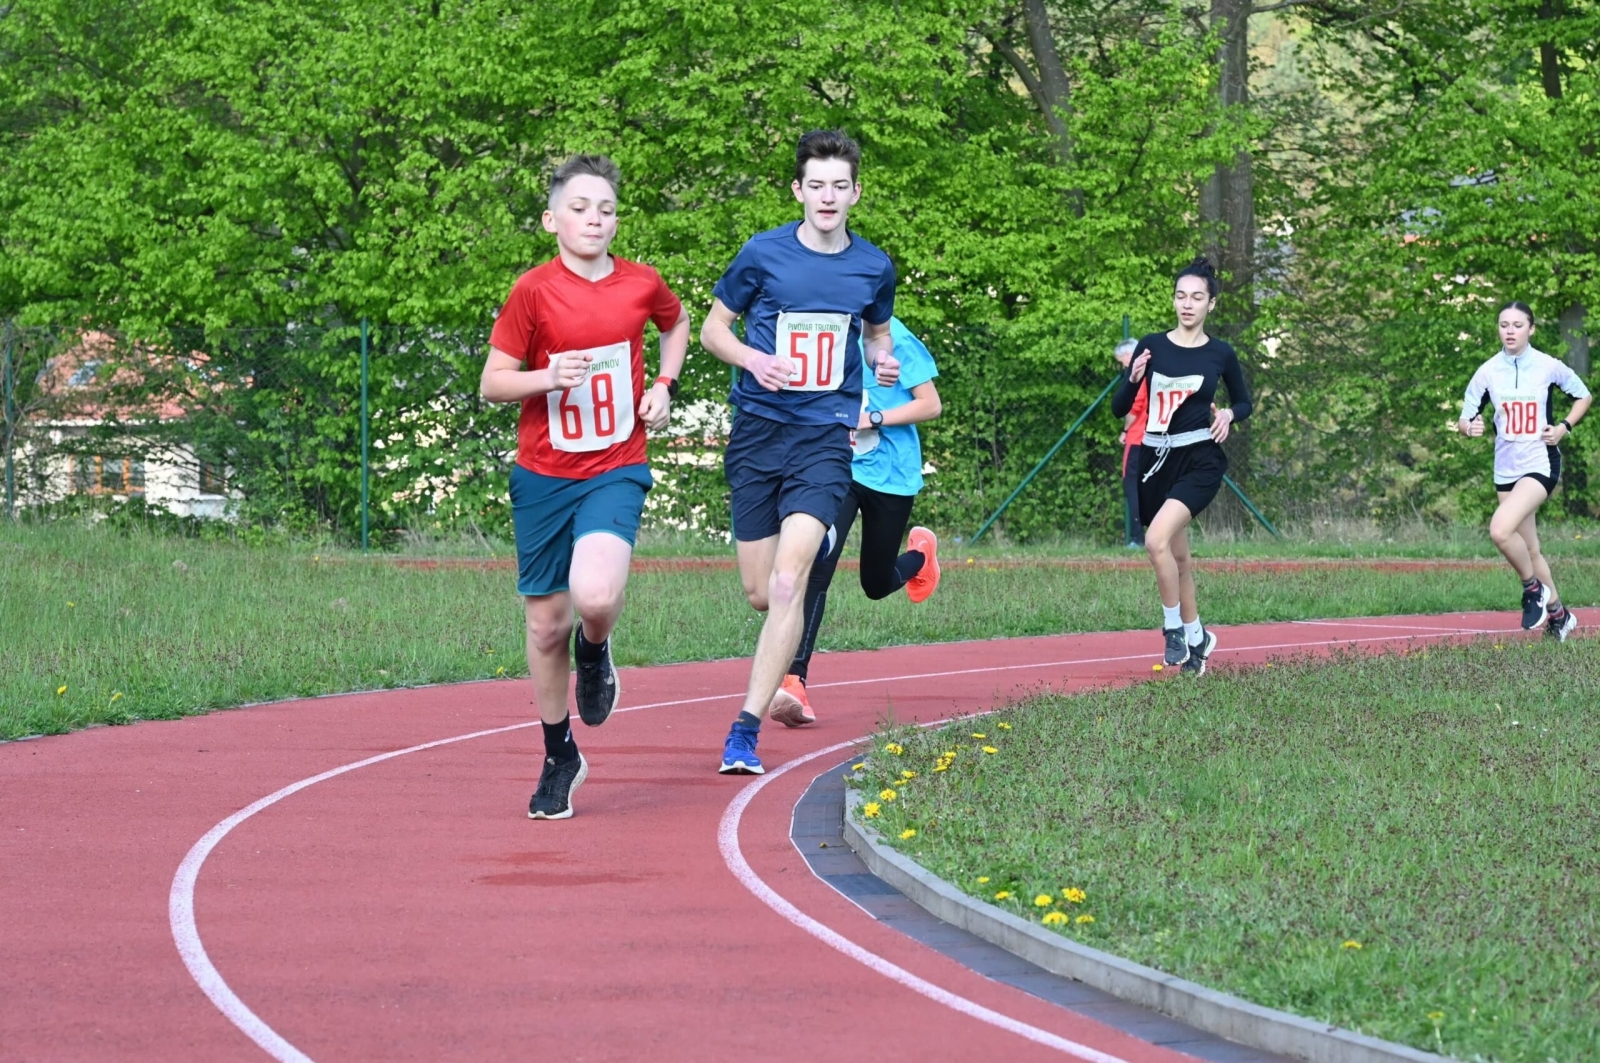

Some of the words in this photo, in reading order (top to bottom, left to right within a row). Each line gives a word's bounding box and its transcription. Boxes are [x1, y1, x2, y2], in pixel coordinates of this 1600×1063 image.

[788, 322, 813, 331] PIVOVAR
[815, 323, 841, 332] TRUTNOV
[789, 332, 834, 387] 50
[559, 373, 616, 440] 68
[1156, 390, 1193, 424] 10
[1502, 402, 1537, 435] 108
